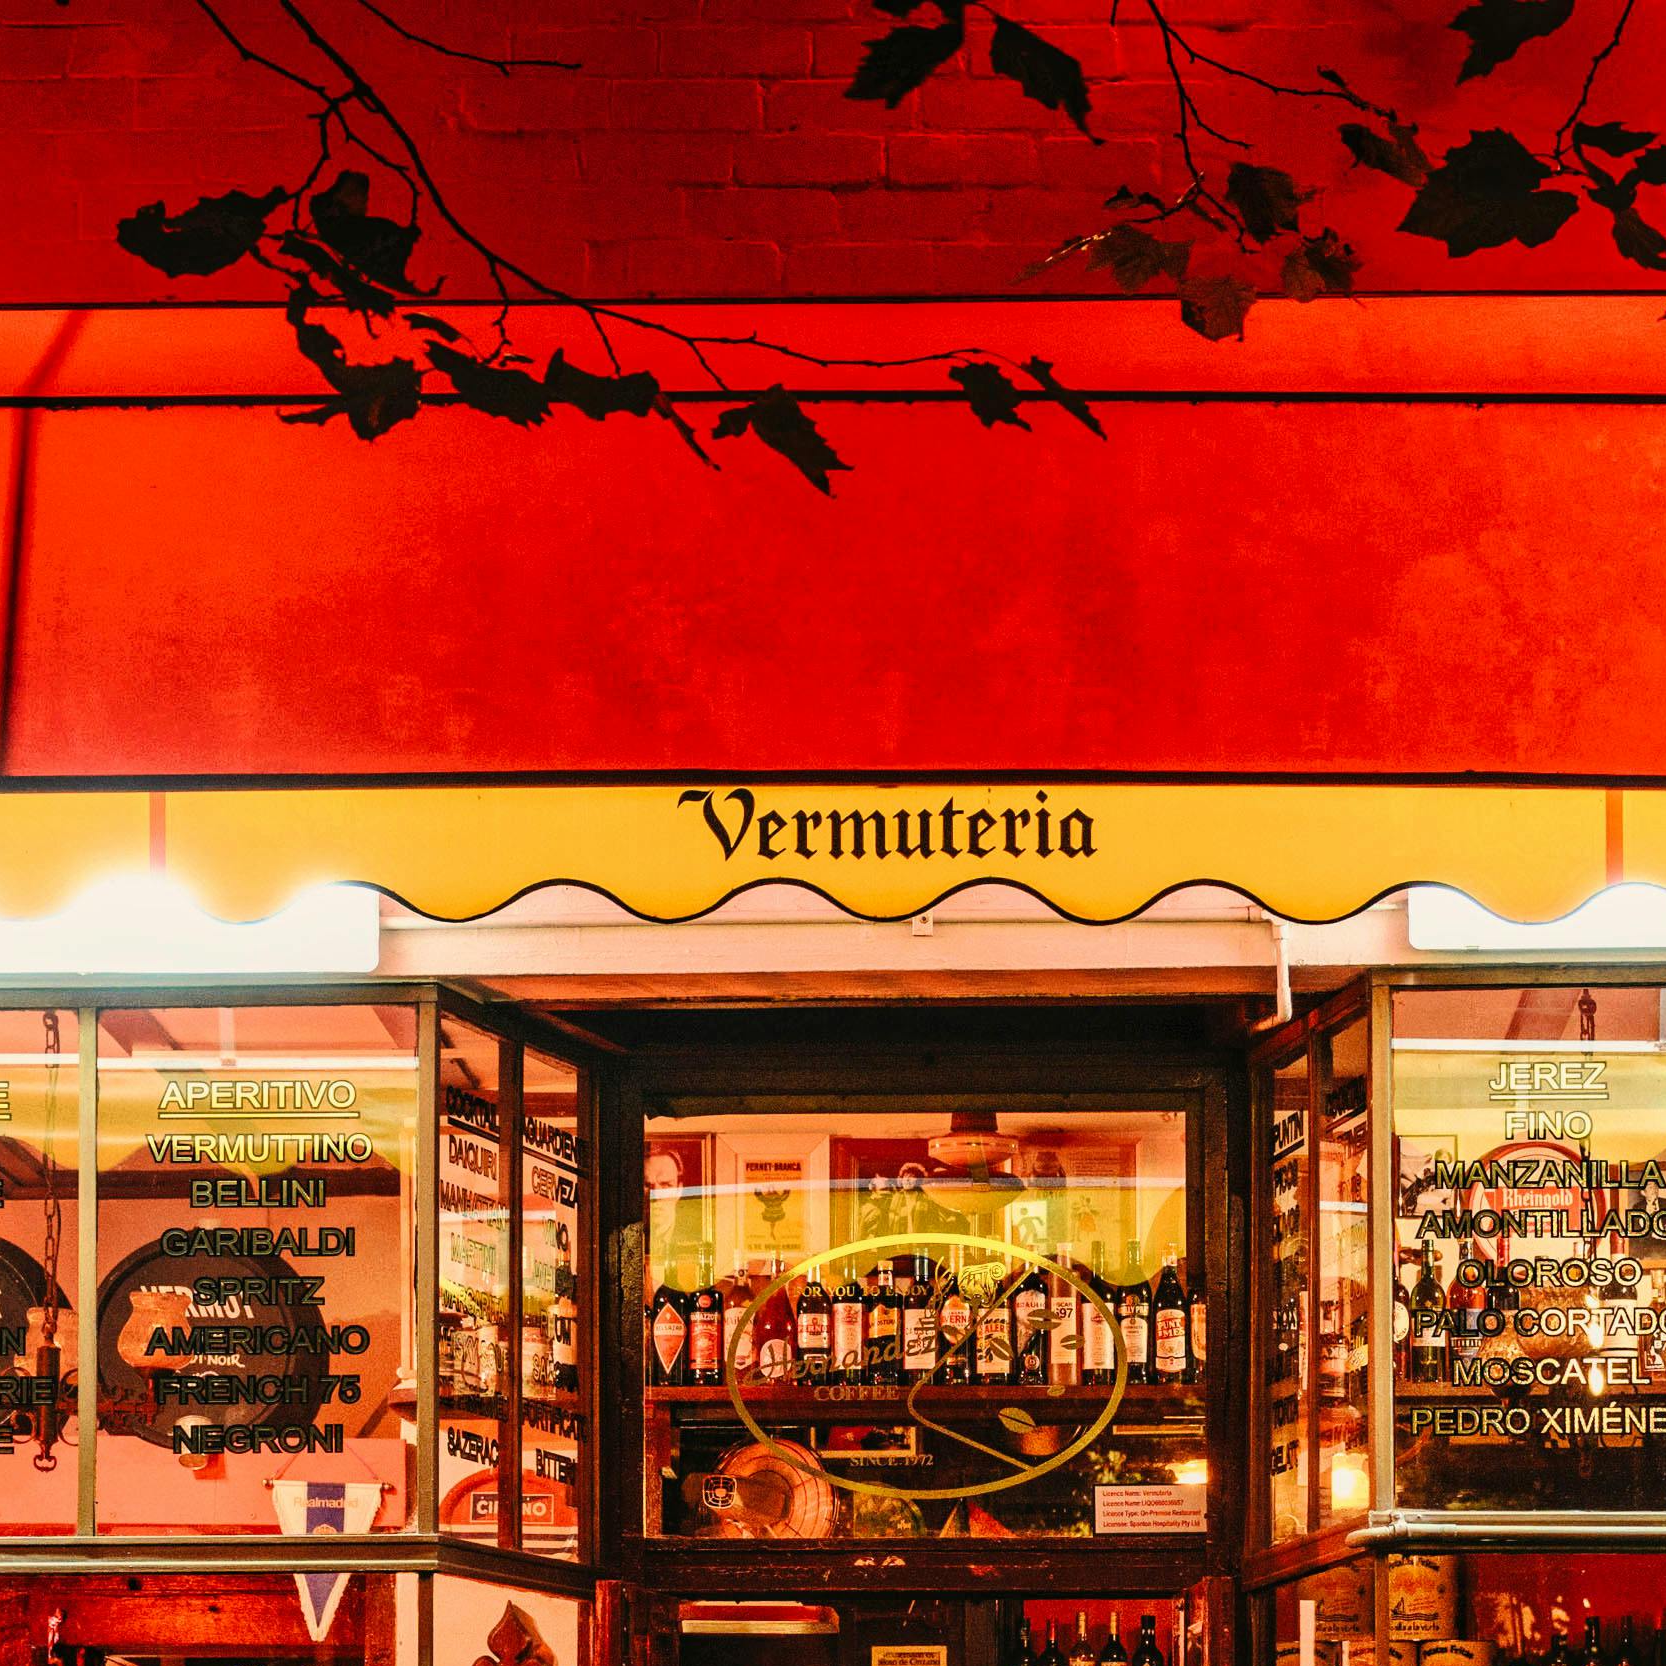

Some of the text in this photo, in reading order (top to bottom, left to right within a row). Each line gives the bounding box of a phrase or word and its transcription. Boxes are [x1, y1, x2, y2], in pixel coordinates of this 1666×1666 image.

[677, 787, 1098, 861] Vermuteria
[1489, 1061, 1608, 1091] JEREZ
[158, 1081, 356, 1110] APERITIVO
[1504, 1111, 1593, 1140] FINO
[146, 1133, 372, 1162] VERMUTTINO
[448, 1134, 497, 1180] DAIQUIRI
[1435, 1159, 1666, 1189] MANZANILLA
[190, 1179, 326, 1208] BELLINI
[1502, 1186, 1574, 1207] Rheingold
[161, 1227, 356, 1257] GARIBALDI
[451, 1232, 496, 1276] MARTINI
[1458, 1258, 1643, 1288] OLOROSO
[194, 1276, 325, 1306] SPRITZ
[828, 1286, 855, 1297] YOU
[1413, 1307, 1505, 1338] PALO
[145, 1325, 370, 1355] AMERICANO
[1453, 1357, 1651, 1387] MOSCATEL
[153, 1374, 362, 1405] FRENCH 75
[814, 1385, 900, 1401] COFFEE
[1411, 1407, 1531, 1436] PEDRO
[172, 1423, 344, 1454] NEGRONI
[447, 1426, 499, 1469] SAZERAC
